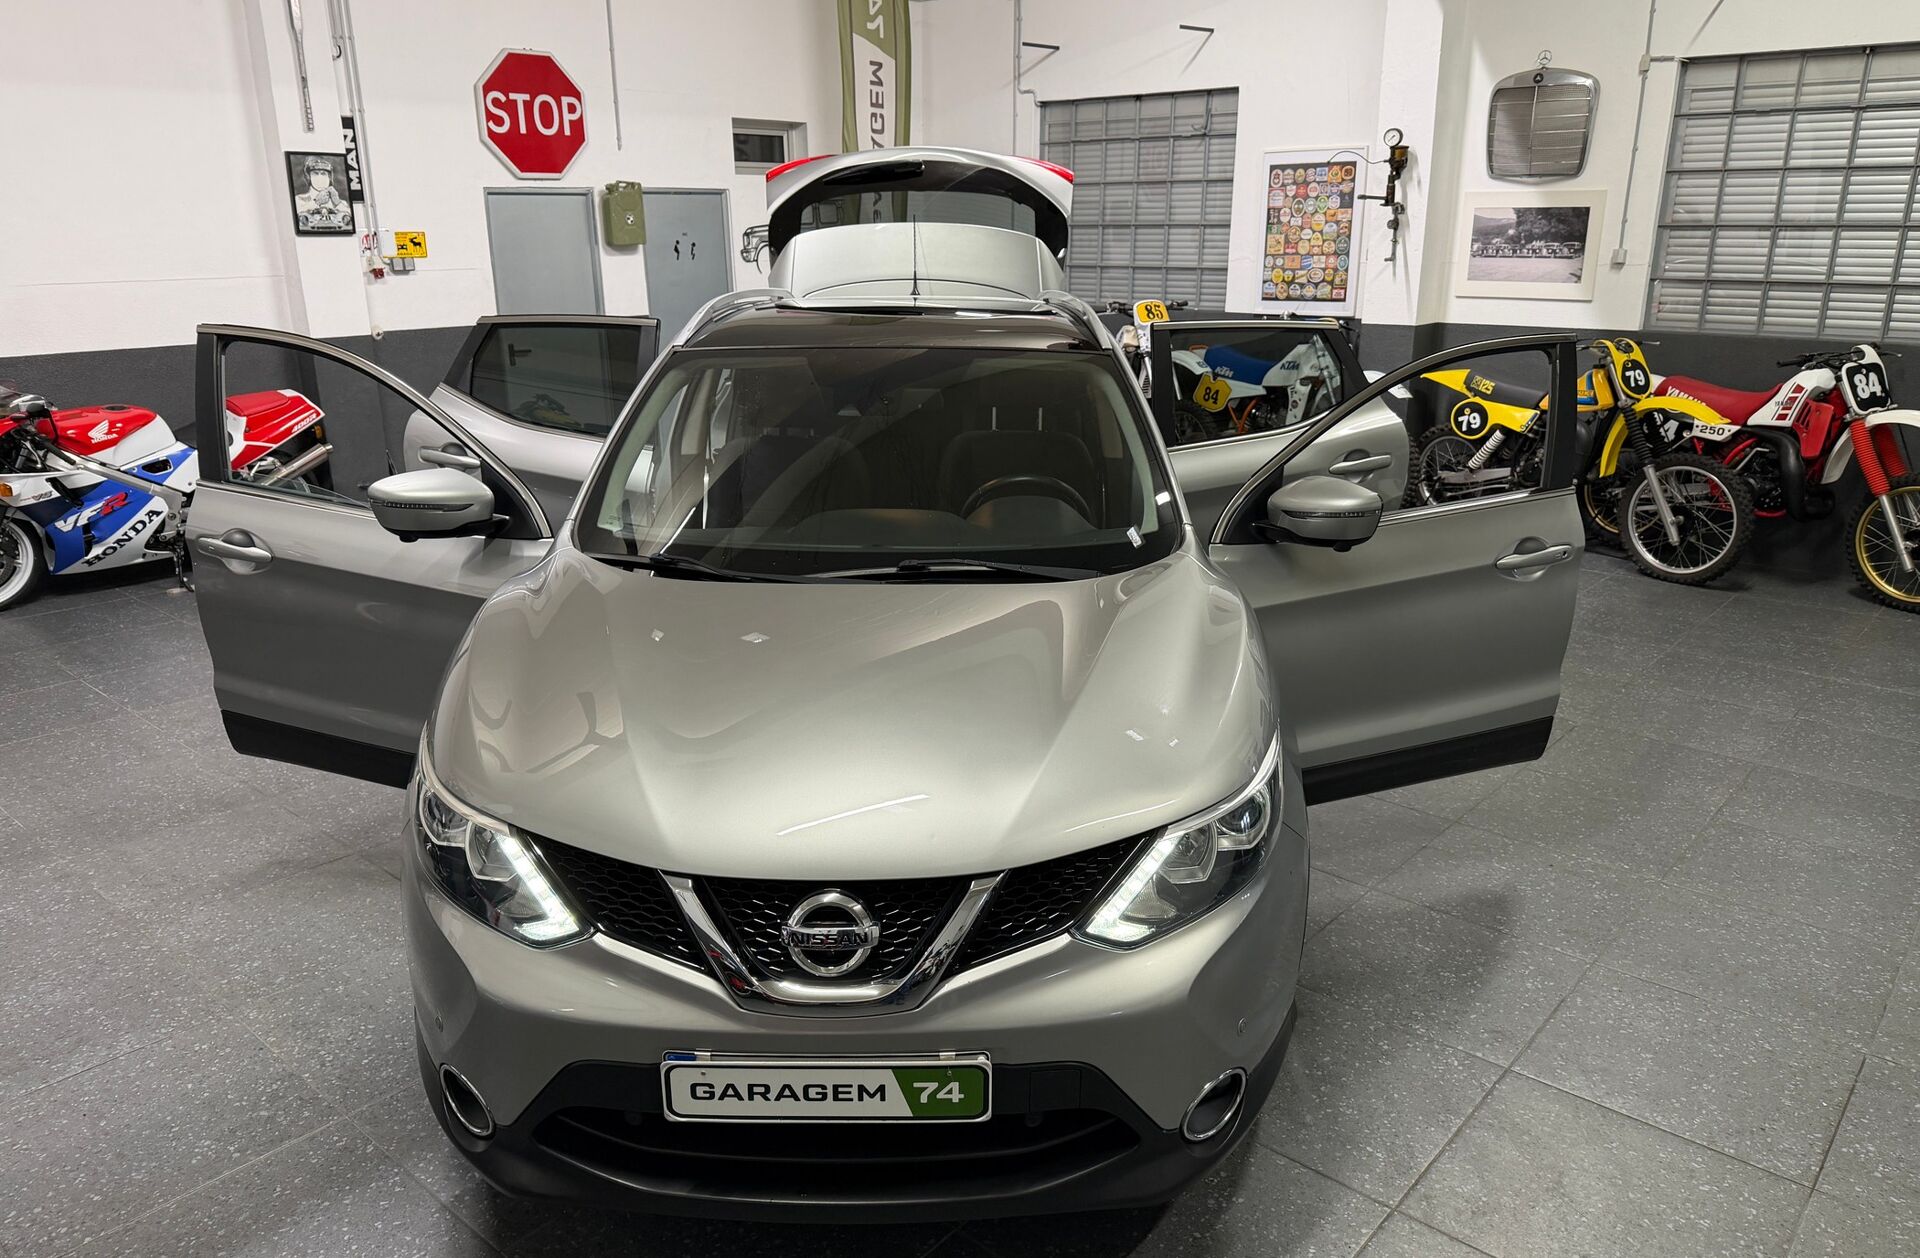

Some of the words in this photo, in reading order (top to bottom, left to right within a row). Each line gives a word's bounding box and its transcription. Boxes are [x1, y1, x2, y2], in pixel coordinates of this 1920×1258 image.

[485, 91, 582, 136] STOP
[343, 128, 361, 191] MAN
[1144, 304, 1164, 320] 85
[1214, 366, 1234, 378] KTM
[1280, 361, 1300, 371] KTM
[1479, 379, 1496, 395] 125
[1625, 369, 1646, 387] 79
[1853, 371, 1882, 399] 84
[1203, 386, 1220, 405] 84
[1458, 412, 1481, 432] 79
[1700, 425, 1725, 436] 250
[91, 433, 118, 444] HONDA
[54, 492, 129, 532] VFR
[81, 508, 164, 567] HONDA
[789, 930, 868, 949] NISSAN
[689, 1082, 886, 1102] GARAGEM
[913, 1081, 964, 1104] 74
